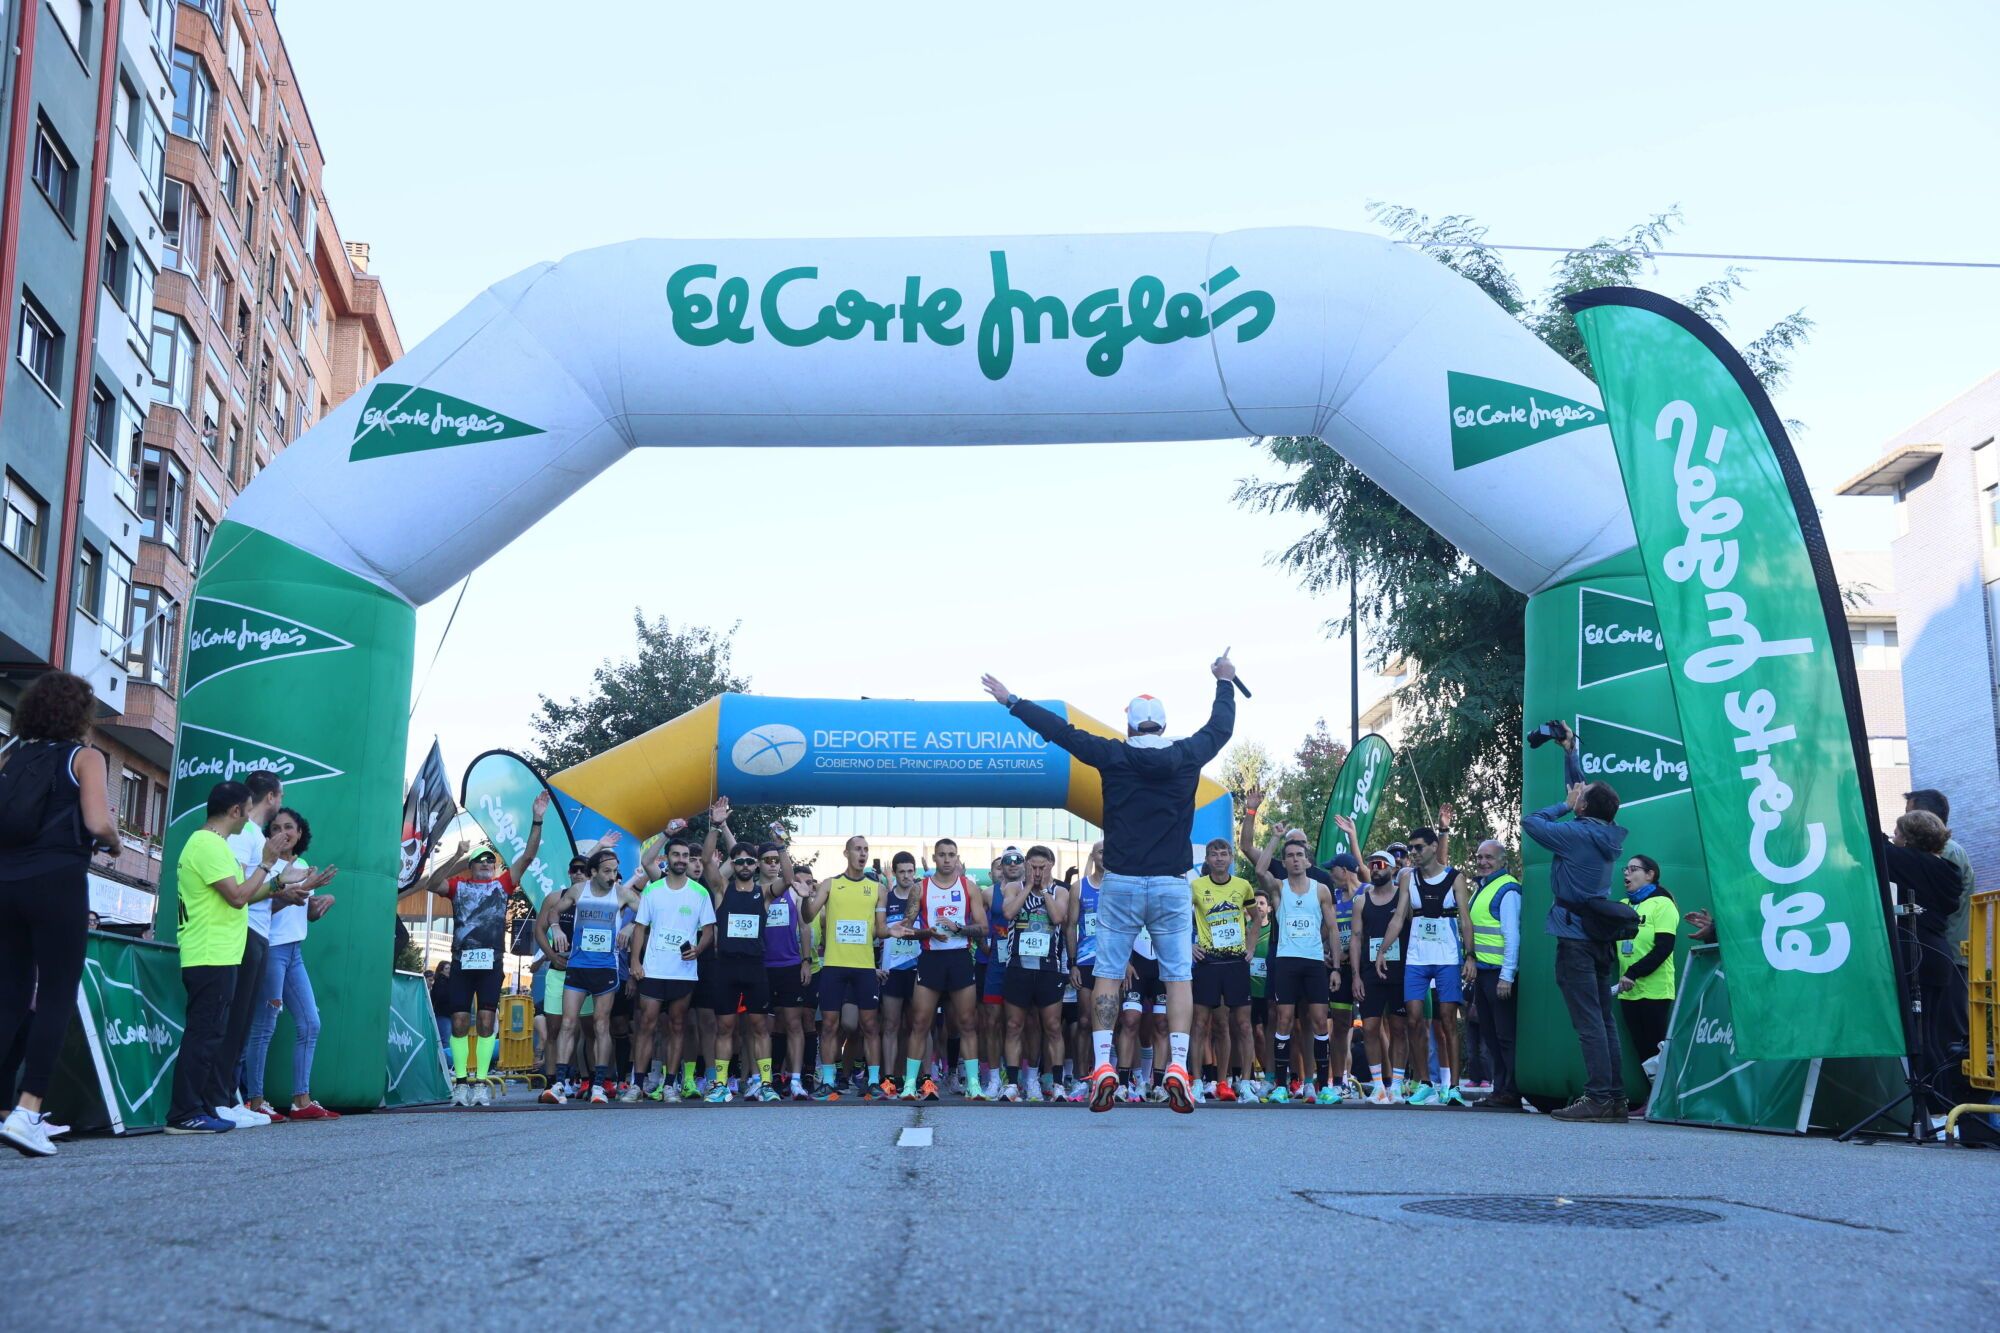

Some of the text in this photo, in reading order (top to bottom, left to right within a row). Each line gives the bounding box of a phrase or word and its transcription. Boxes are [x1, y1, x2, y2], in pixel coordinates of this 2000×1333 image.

[666, 250, 1276, 381] El Corte Inglés
[362, 402, 505, 437] El Corte Inglés
[1453, 396, 1596, 430] El Corte Inglés
[190, 618, 307, 652] El Corte Inglés
[1584, 623, 1604, 645] El
[1604, 623, 1653, 644] Corte
[1655, 399, 1851, 975] El Corte Inglés
[813, 729, 1049, 750] DEPORTE ASTURIANO
[177, 758, 188, 780] El
[188, 755, 224, 775] Corte
[876, 757, 898, 769] DEL
[968, 758, 983, 769] DE
[1581, 748, 1689, 782] El Corte Ing
[734, 919, 753, 929] 353
[842, 925, 861, 934] 243
[1291, 919, 1310, 928] 450
[1425, 923, 1437, 932] 81
[588, 934, 606, 943] 356
[664, 933, 683, 944] 412
[1218, 928, 1236, 938] 259
[1025, 937, 1043, 947] 481
[468, 951, 487, 960] 218
[1695, 1017, 1709, 1044] El
